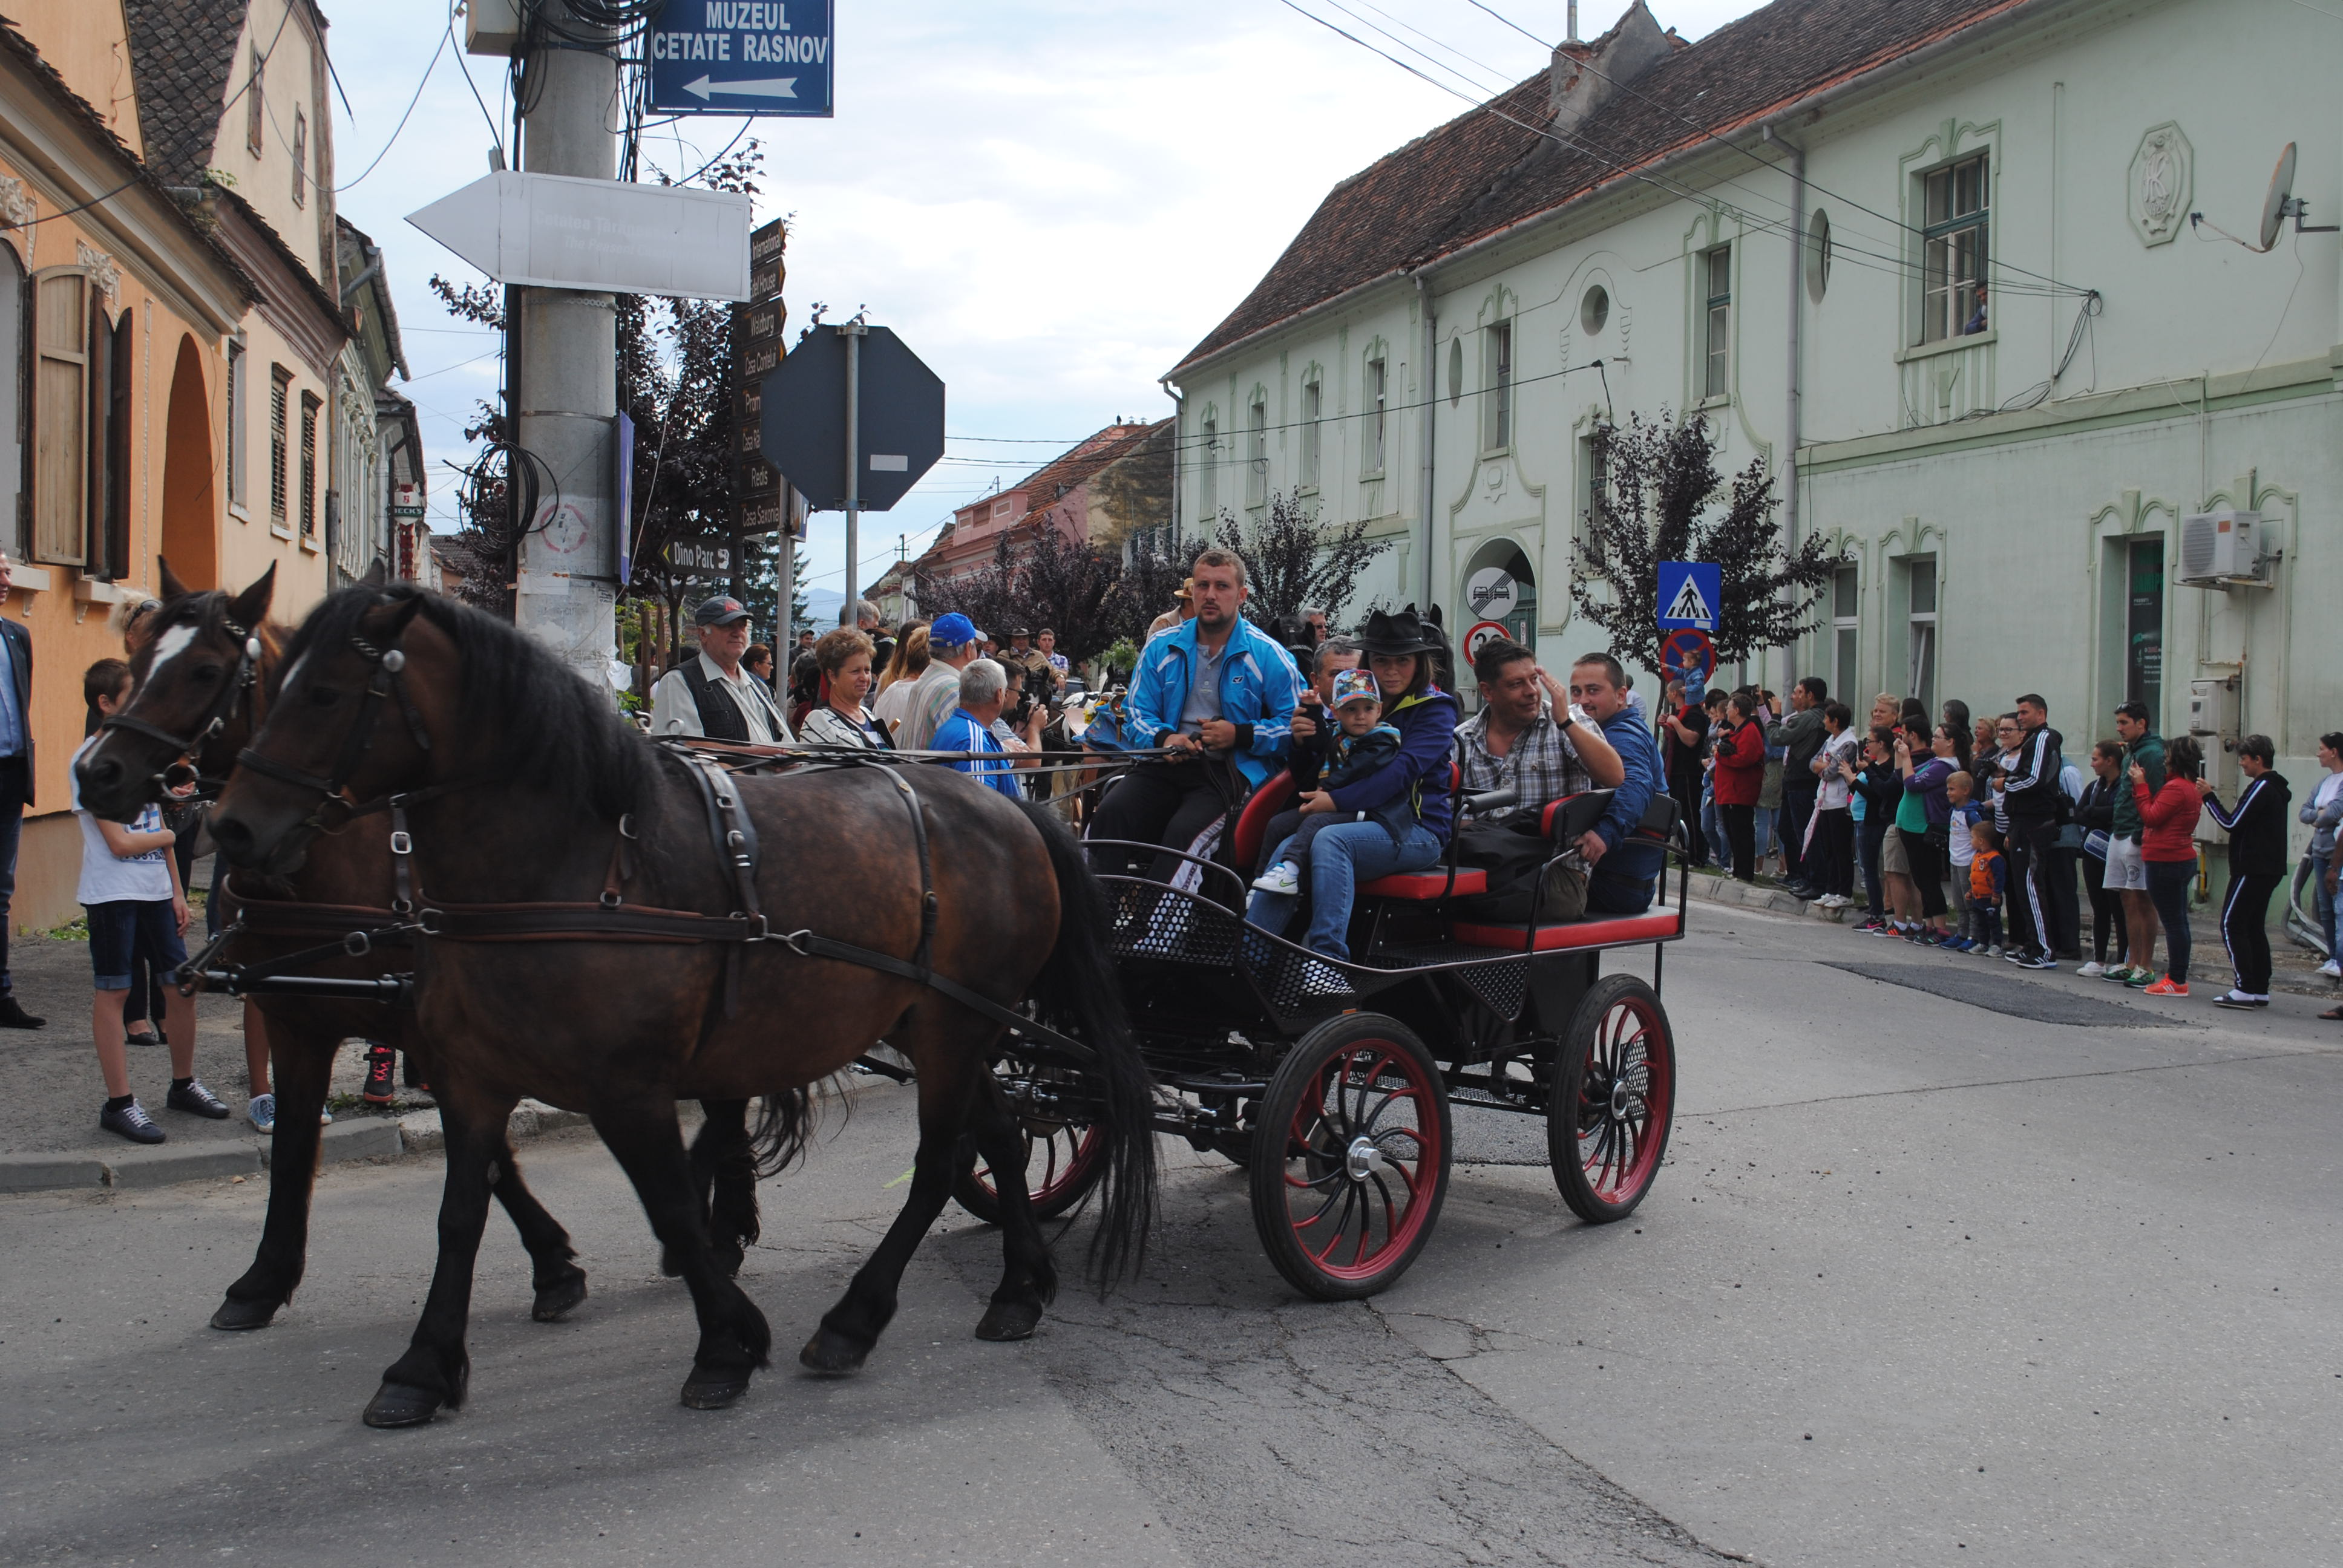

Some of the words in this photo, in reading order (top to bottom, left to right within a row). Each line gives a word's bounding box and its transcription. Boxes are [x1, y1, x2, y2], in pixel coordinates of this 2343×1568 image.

[706, 1, 790, 30] MUZEUL
[653, 33, 730, 60] CETATE
[744, 34, 828, 64] RASNOV
[752, 227, 781, 261] International
[759, 272, 776, 295] House
[750, 313, 775, 337] Waldburg
[746, 356, 756, 376] Casa
[742, 433, 753, 452] Casa
[751, 465, 768, 488] Redis
[742, 508, 756, 528] Casa
[757, 501, 779, 525] Saxonia
[674, 541, 694, 567] Dino
[695, 544, 715, 569] Parc
